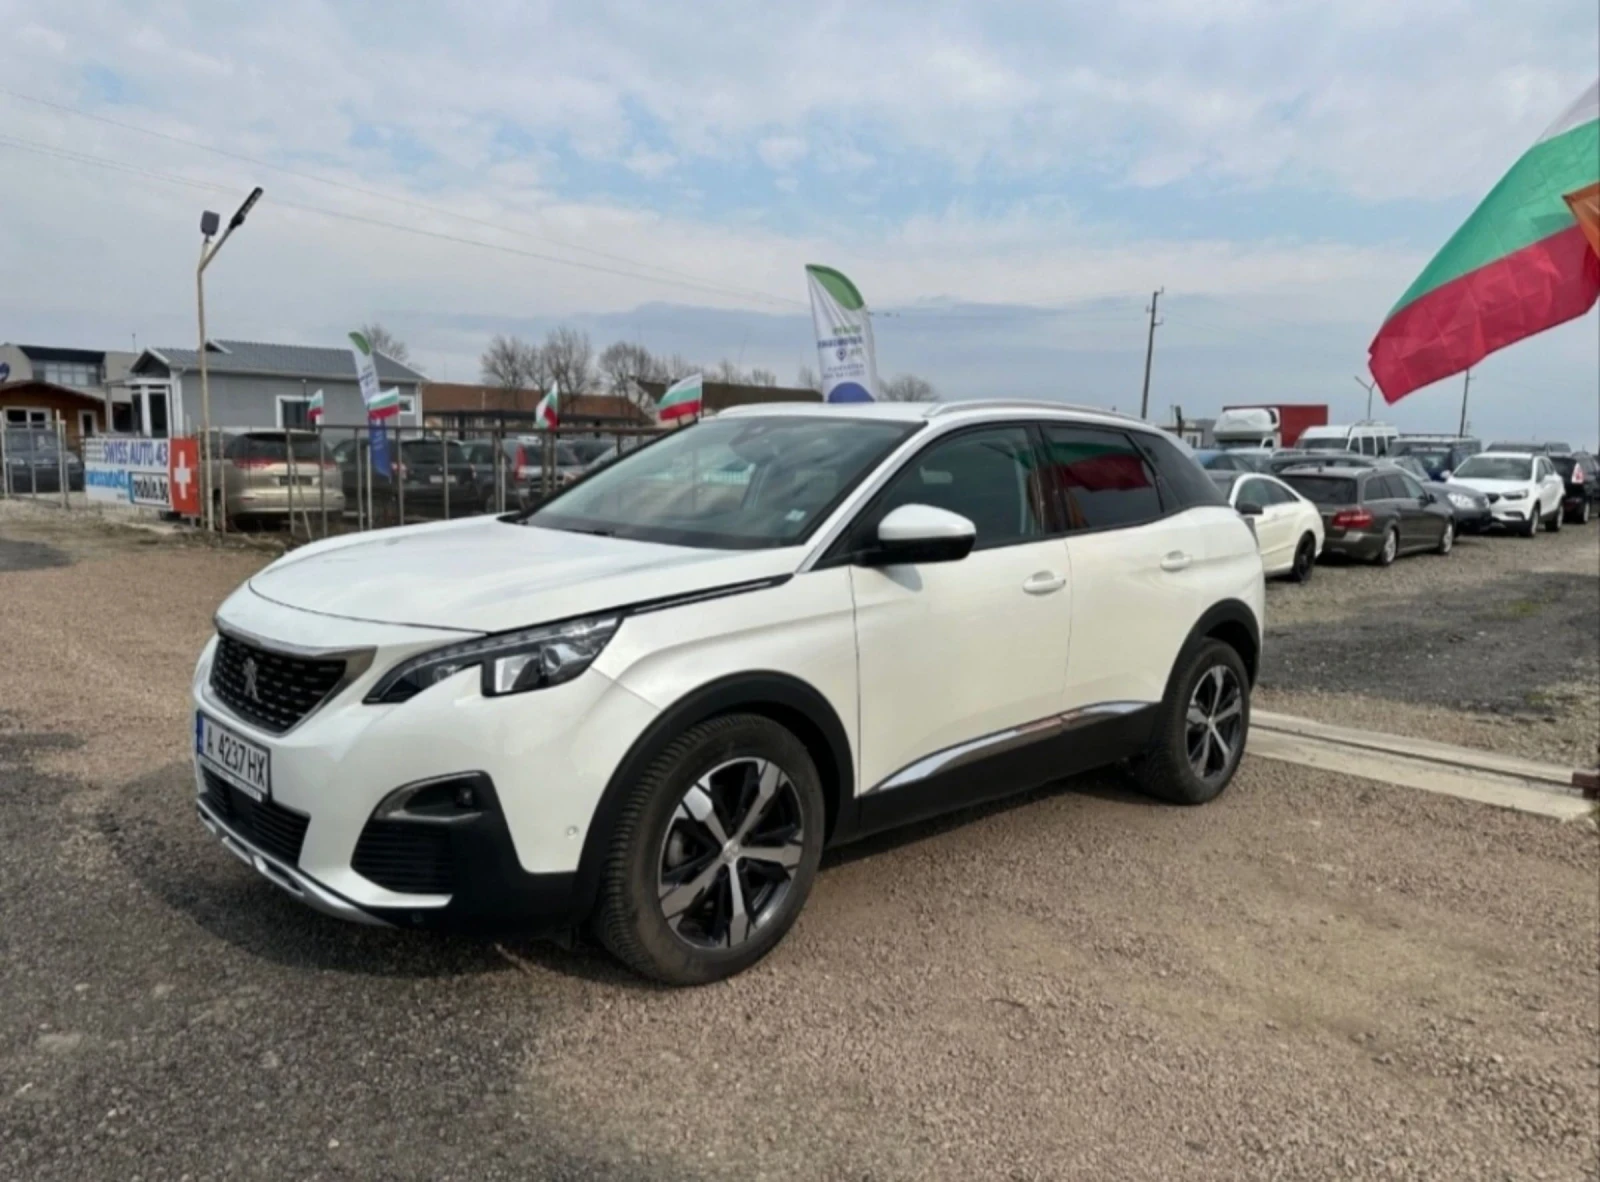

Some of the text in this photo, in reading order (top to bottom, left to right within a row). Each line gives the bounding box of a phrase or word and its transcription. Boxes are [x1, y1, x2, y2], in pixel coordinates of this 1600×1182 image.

[104, 440, 127, 464] SWISS
[129, 441, 154, 466] AUTO
[156, 442, 168, 467] 43
